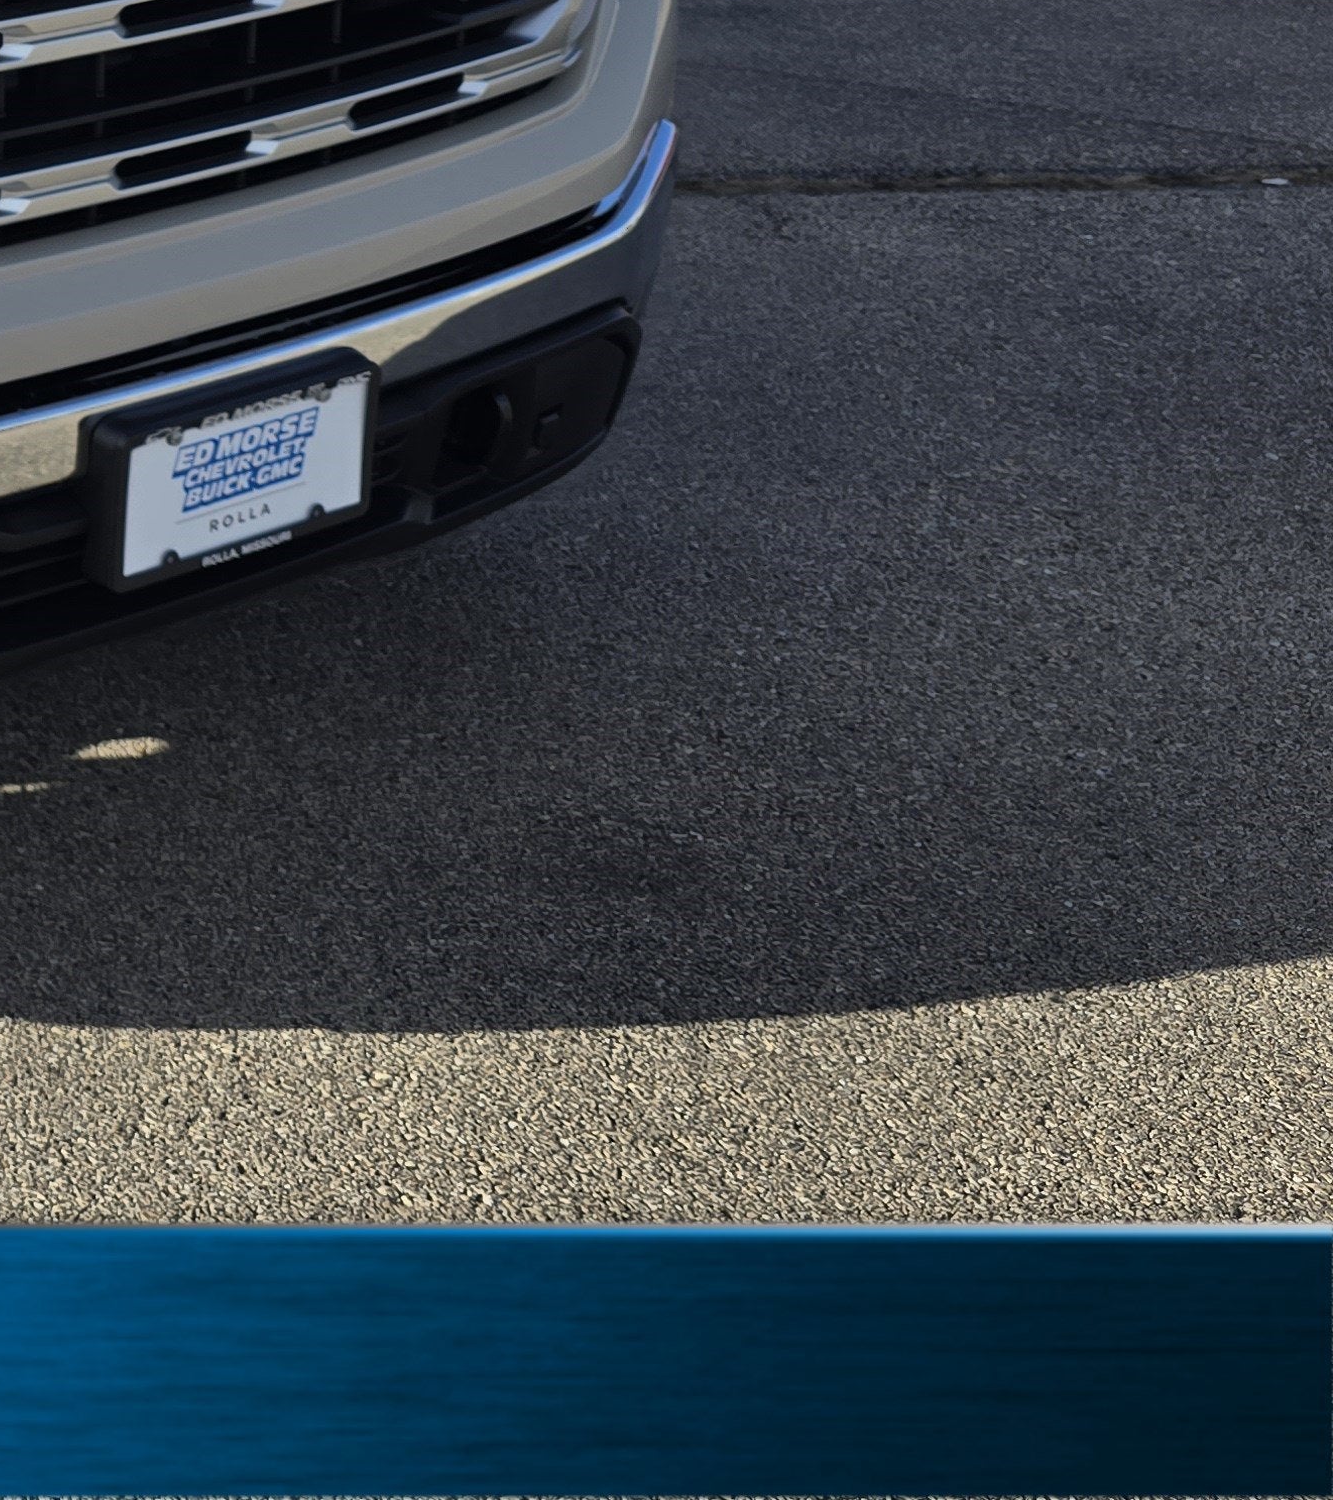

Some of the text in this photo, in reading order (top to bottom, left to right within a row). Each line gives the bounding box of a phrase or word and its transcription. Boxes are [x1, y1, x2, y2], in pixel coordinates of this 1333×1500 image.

[173, 438, 218, 476] ED
[216, 407, 319, 460] MORSE
[184, 437, 306, 488] CHEVROLET
[184, 454, 305, 510] BUICK GMC
[208, 502, 271, 533] ROLLA
